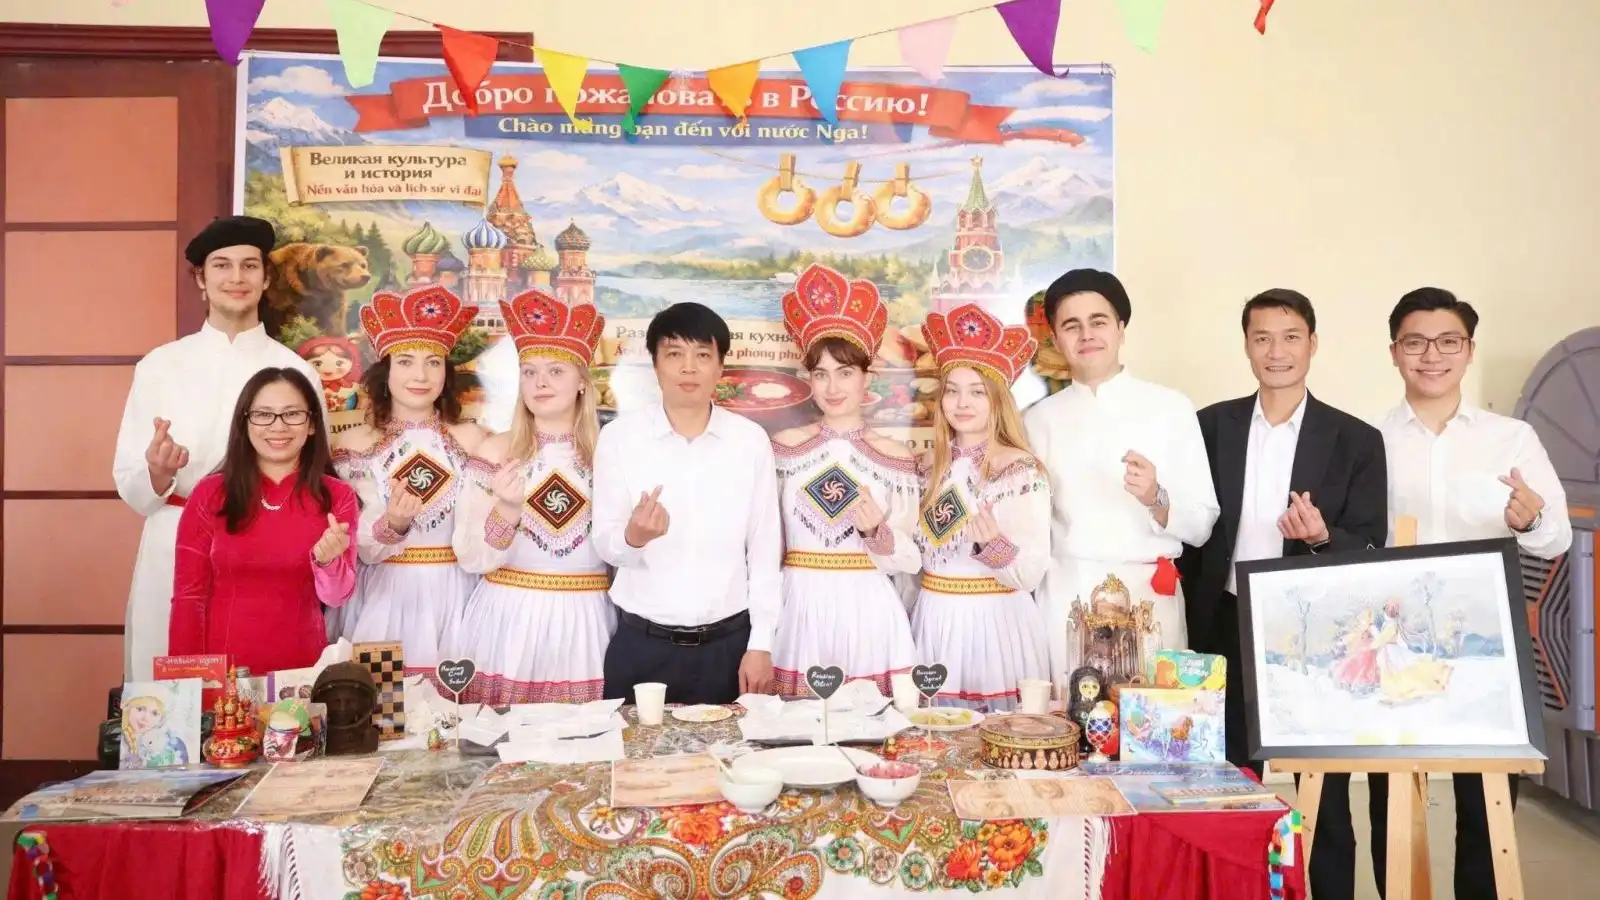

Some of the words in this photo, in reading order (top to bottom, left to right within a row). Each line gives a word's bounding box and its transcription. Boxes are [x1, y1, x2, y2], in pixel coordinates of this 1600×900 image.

[762, 91, 780, 108] в
[498, 117, 553, 133] Chào
[674, 119, 713, 137] đến
[757, 124, 809, 139] nước
[816, 124, 868, 143] Nga!
[310, 152, 382, 166] Великая
[387, 155, 467, 168] культура
[344, 169, 355, 179] и
[361, 169, 433, 181] история
